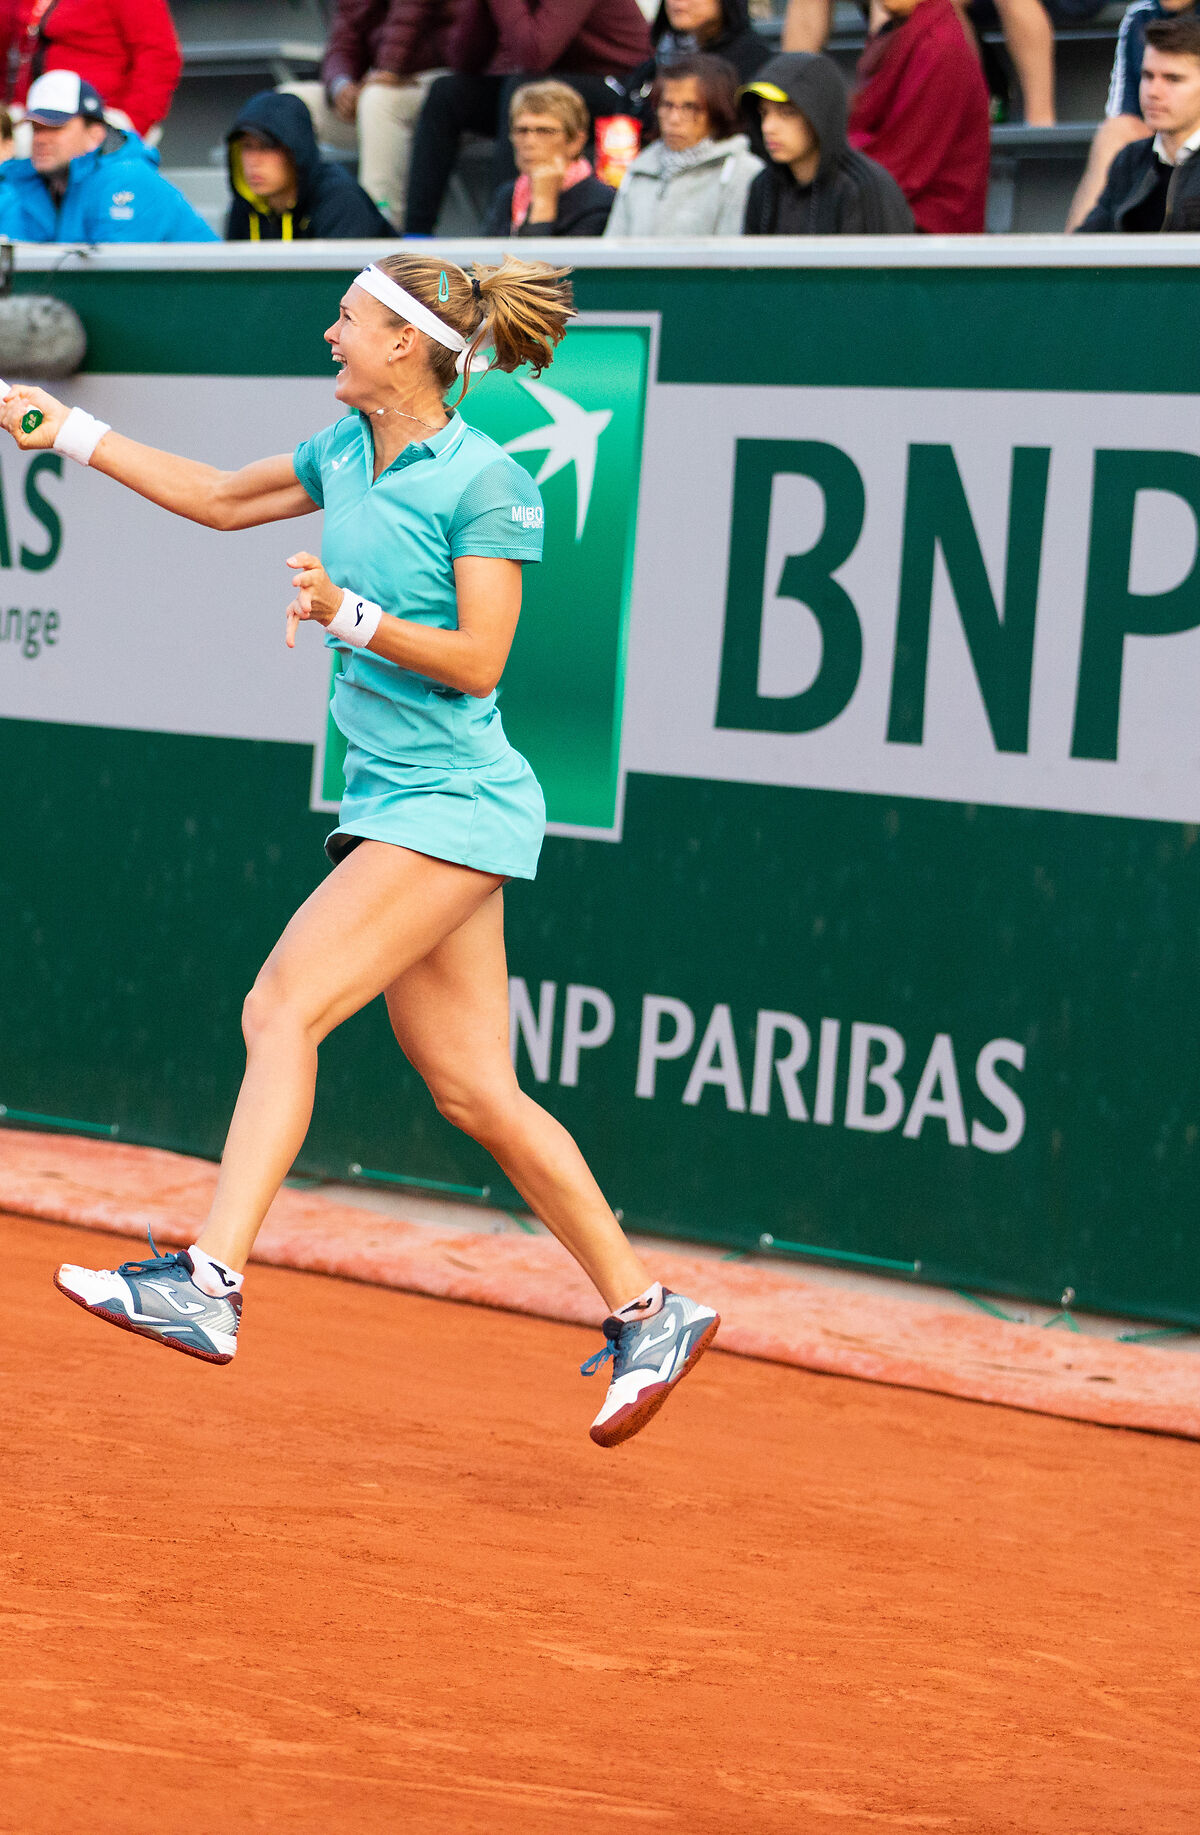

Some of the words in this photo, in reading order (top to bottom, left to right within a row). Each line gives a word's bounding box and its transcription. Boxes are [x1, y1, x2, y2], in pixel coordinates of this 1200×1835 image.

[715, 437, 1200, 763] BNP
[508, 975, 615, 1087] NP
[635, 993, 1027, 1154] PARIBAS
